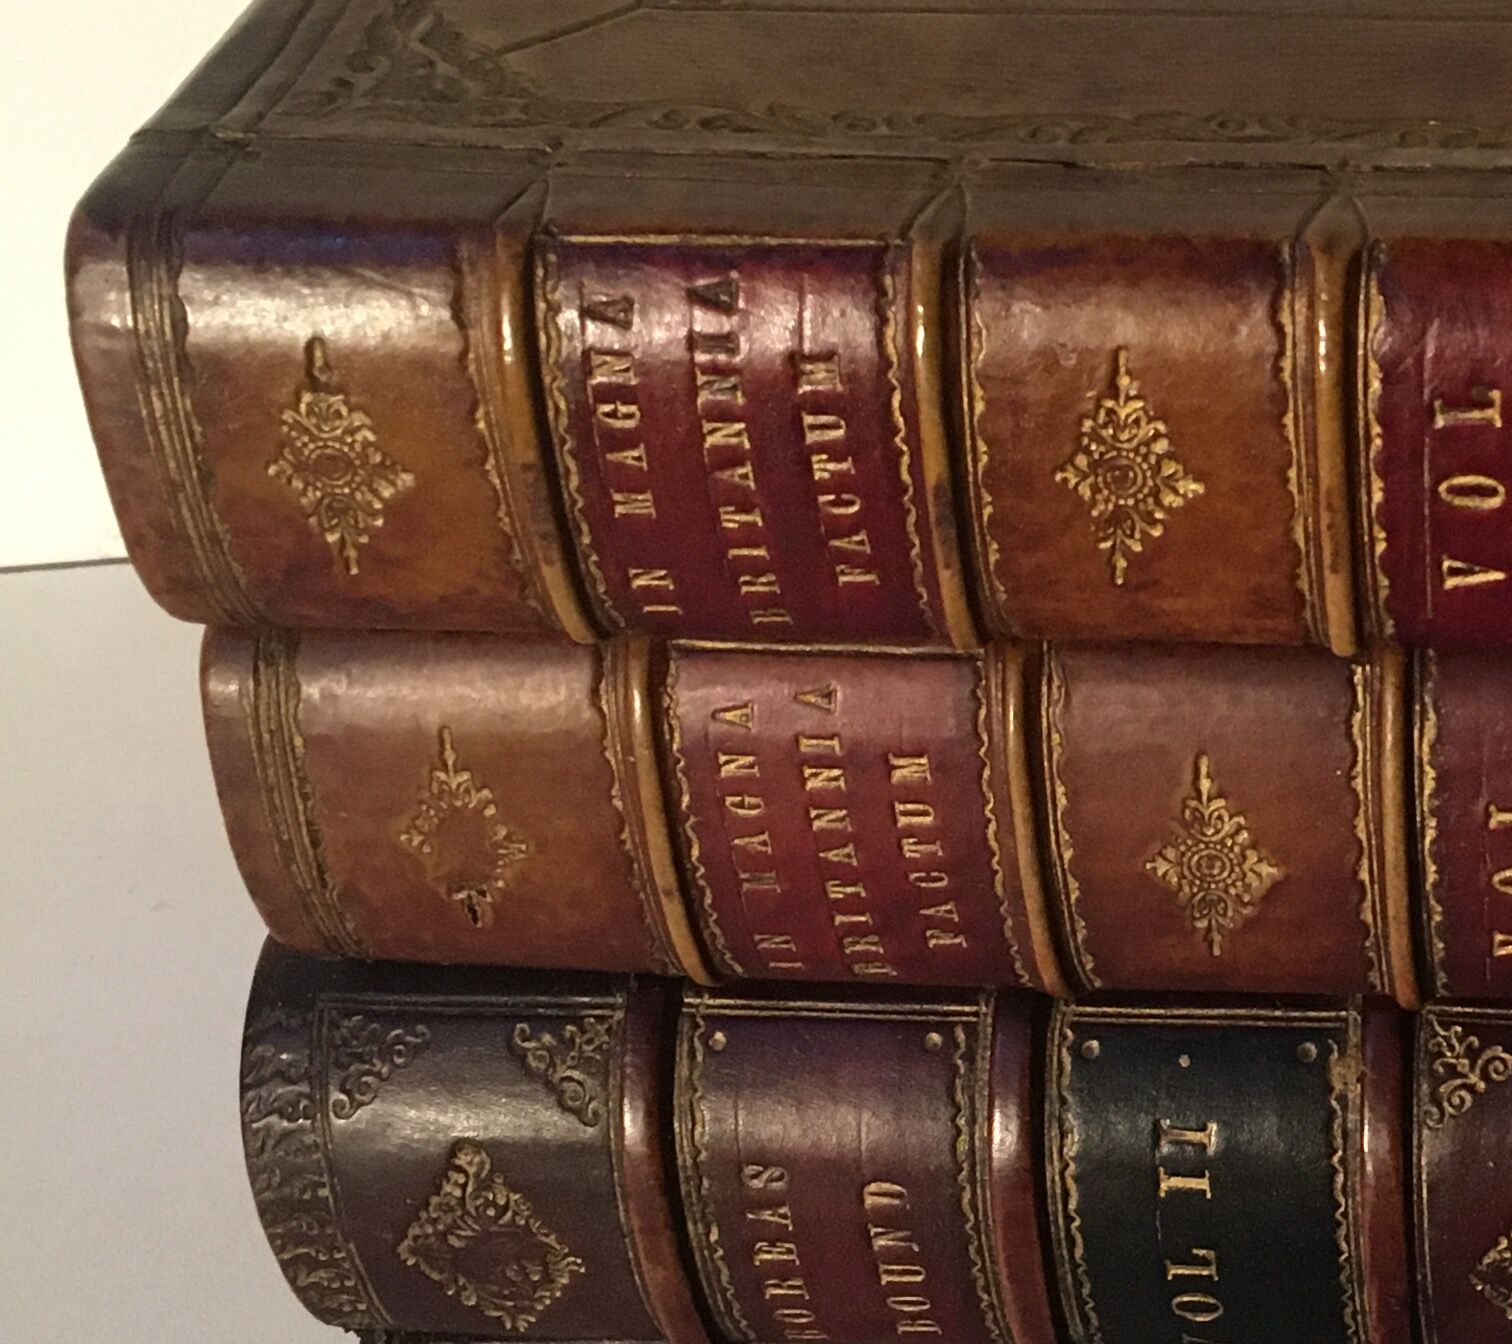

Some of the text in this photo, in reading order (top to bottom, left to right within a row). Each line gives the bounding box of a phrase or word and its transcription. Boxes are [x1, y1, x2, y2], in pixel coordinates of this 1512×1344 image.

[586, 290, 682, 615] IN MAGNA
[689, 270, 793, 625] BRITANNIA
[794, 350, 880, 586] FACTUM
[1433, 387, 1507, 590] VOL
[711, 699, 805, 972] IN MAGNA
[797, 683, 897, 976] BRITANNIA
[888, 749, 967, 950] FACTUM
[741, 1161, 829, 1341] BOREAS
[863, 1179, 942, 1335] BOUND
[1156, 1118, 1217, 1198] II
